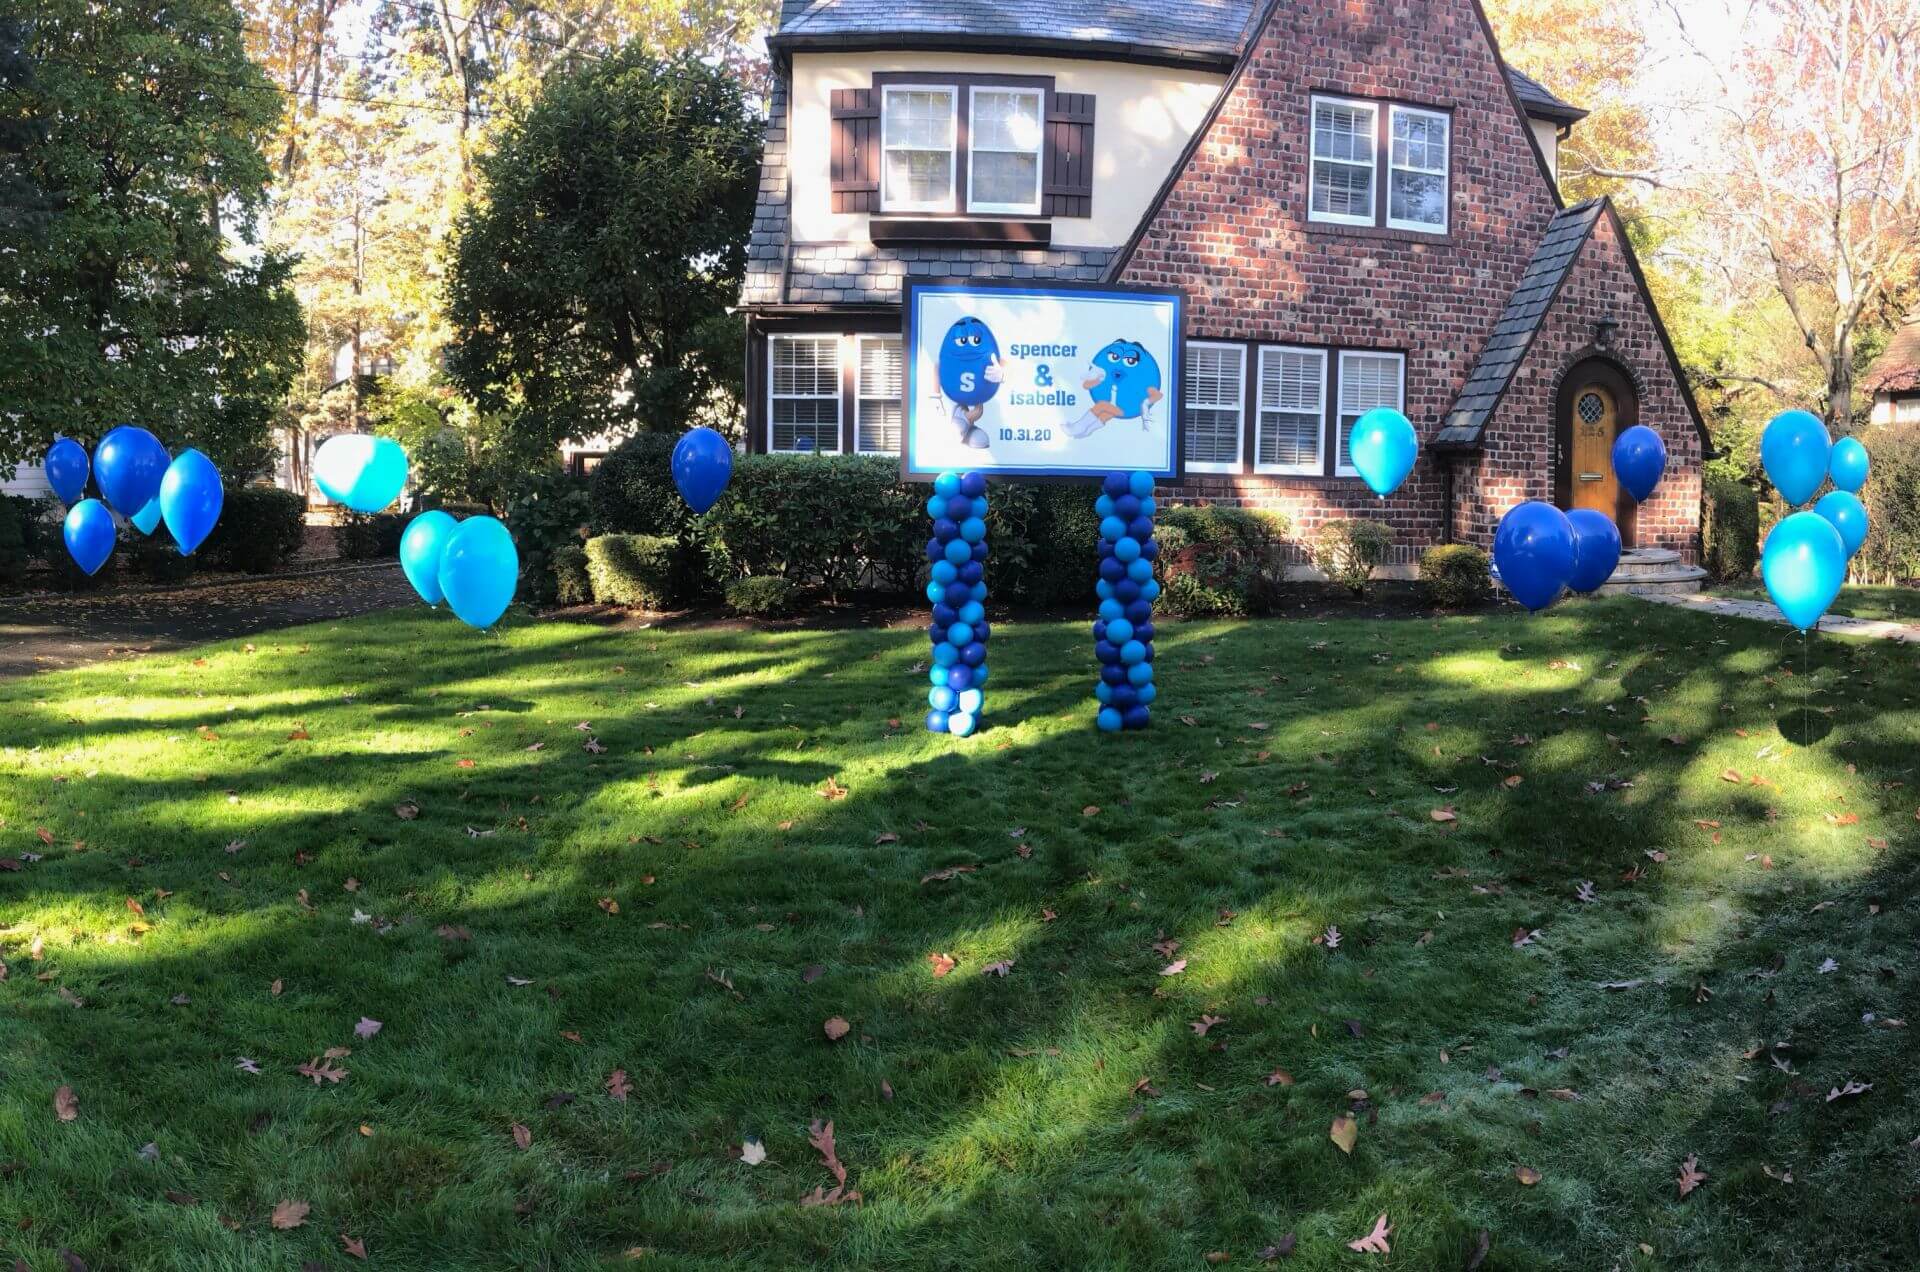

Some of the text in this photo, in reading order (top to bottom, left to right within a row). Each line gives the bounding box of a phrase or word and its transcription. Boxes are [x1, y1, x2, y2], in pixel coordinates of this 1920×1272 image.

[1010, 344, 1078, 360] spencer
[1034, 364, 1054, 387] &
[1010, 390, 1076, 406] isabelle
[999, 428, 1052, 441] 10.31.20
